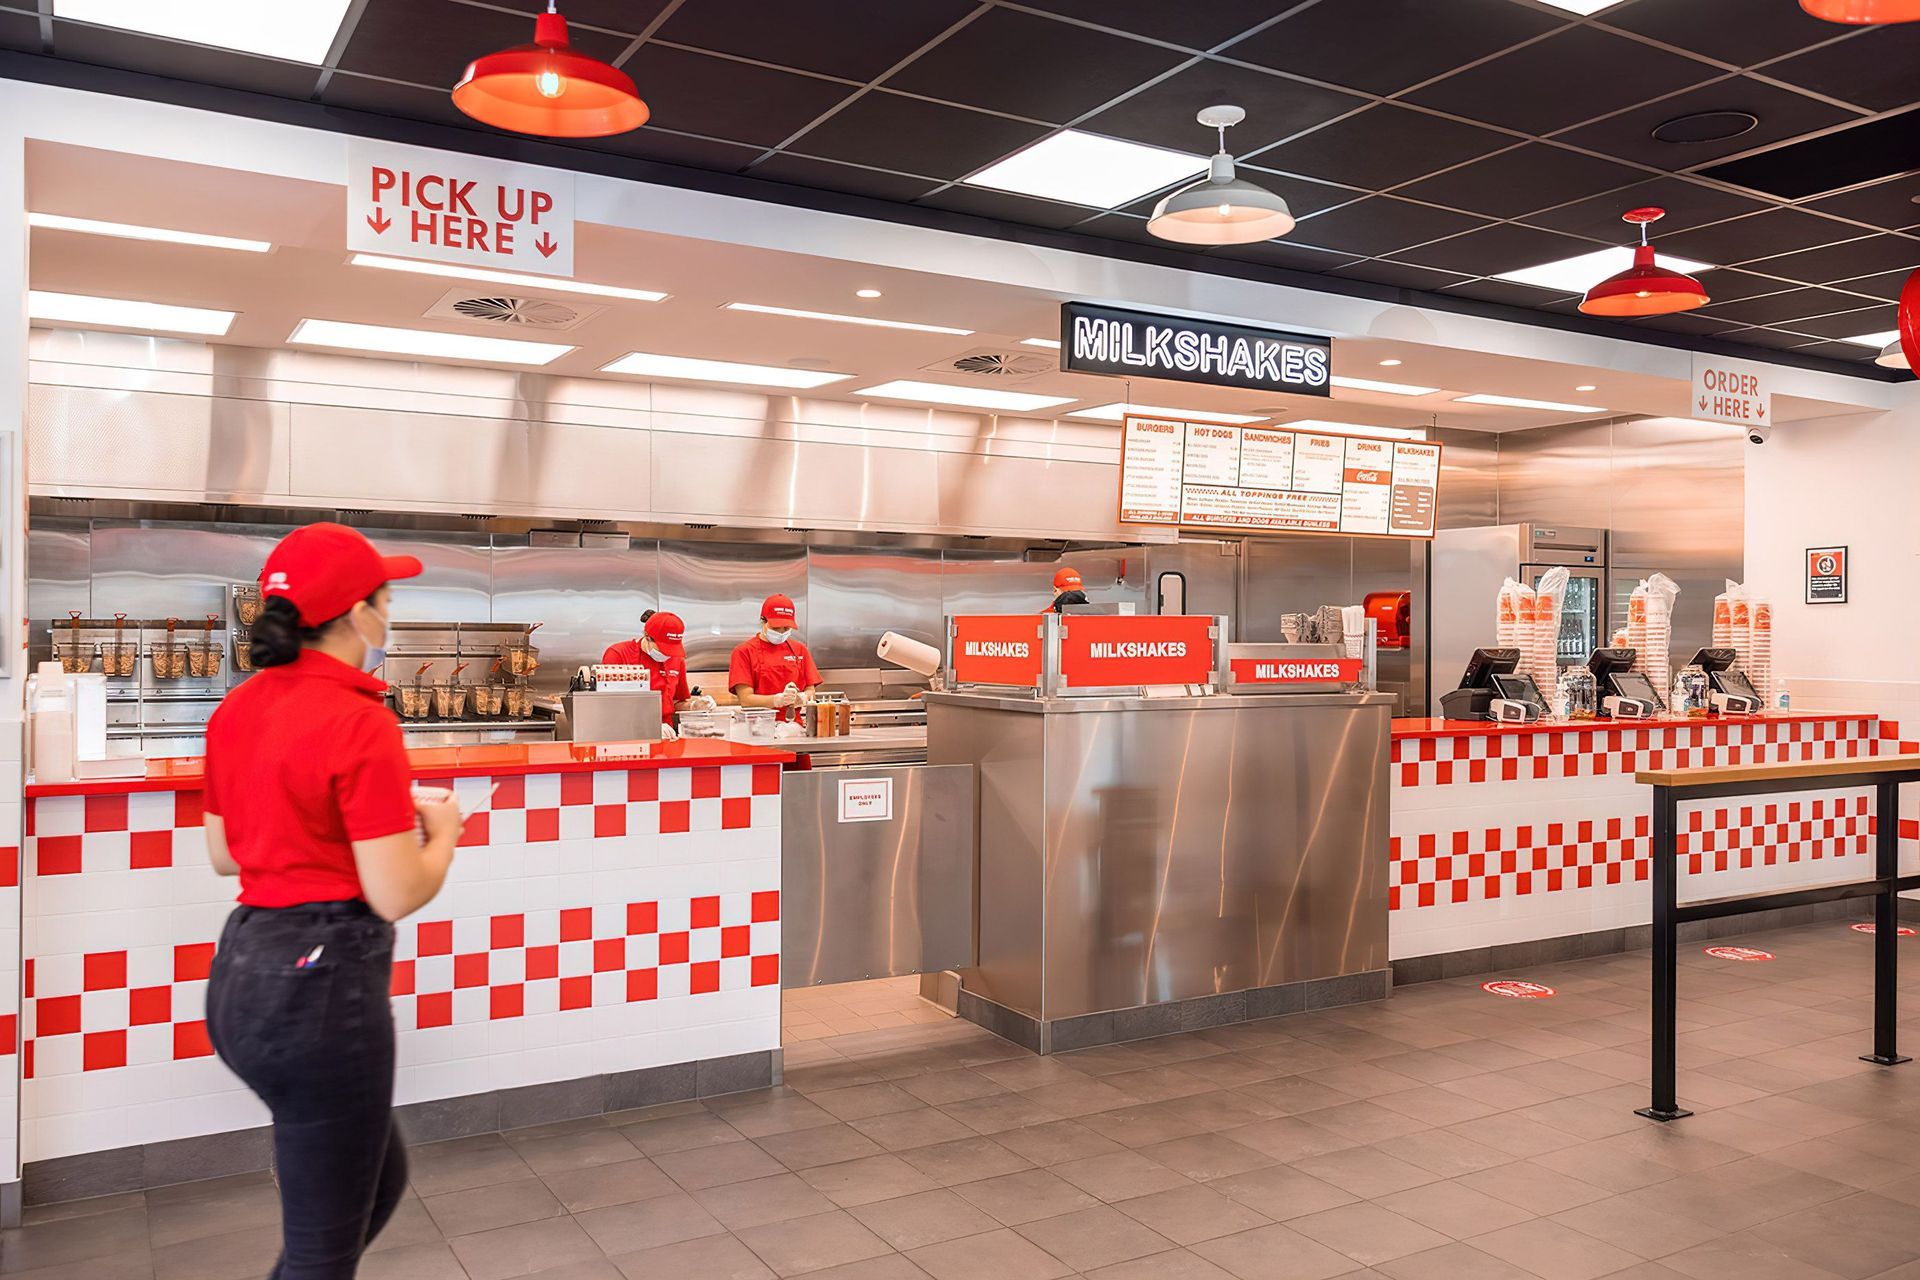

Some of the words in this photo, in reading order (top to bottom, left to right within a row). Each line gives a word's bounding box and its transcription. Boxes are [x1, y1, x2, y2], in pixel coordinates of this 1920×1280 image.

[372, 166, 478, 216] PICK
[497, 185, 554, 225] UP
[411, 209, 514, 256] HERE
[1074, 316, 1328, 387] MILKSHAKES
[1703, 368, 1759, 397] ORDER
[1713, 395, 1750, 419] HERE
[1136, 422, 1175, 434] BURGERS
[1193, 427, 1210, 437] HOT
[1211, 429, 1233, 440] DOGS
[1243, 432, 1292, 445] SANDWICHES
[1310, 438, 1331, 448] FRIES
[1357, 443, 1382, 452] DRINKS
[1396, 446, 1435, 457] MILKSHAKES
[1220, 489, 1237, 497] ALL
[1240, 490, 1284, 500] TOPPINGS
[1286, 493, 1308, 502] FREE
[1191, 513, 1205, 522] ALL
[965, 640, 1029, 658] MILKSHAKES
[1090, 641, 1187, 659] MILKSHAKES
[1255, 663, 1340, 679] MILKSHAKES
